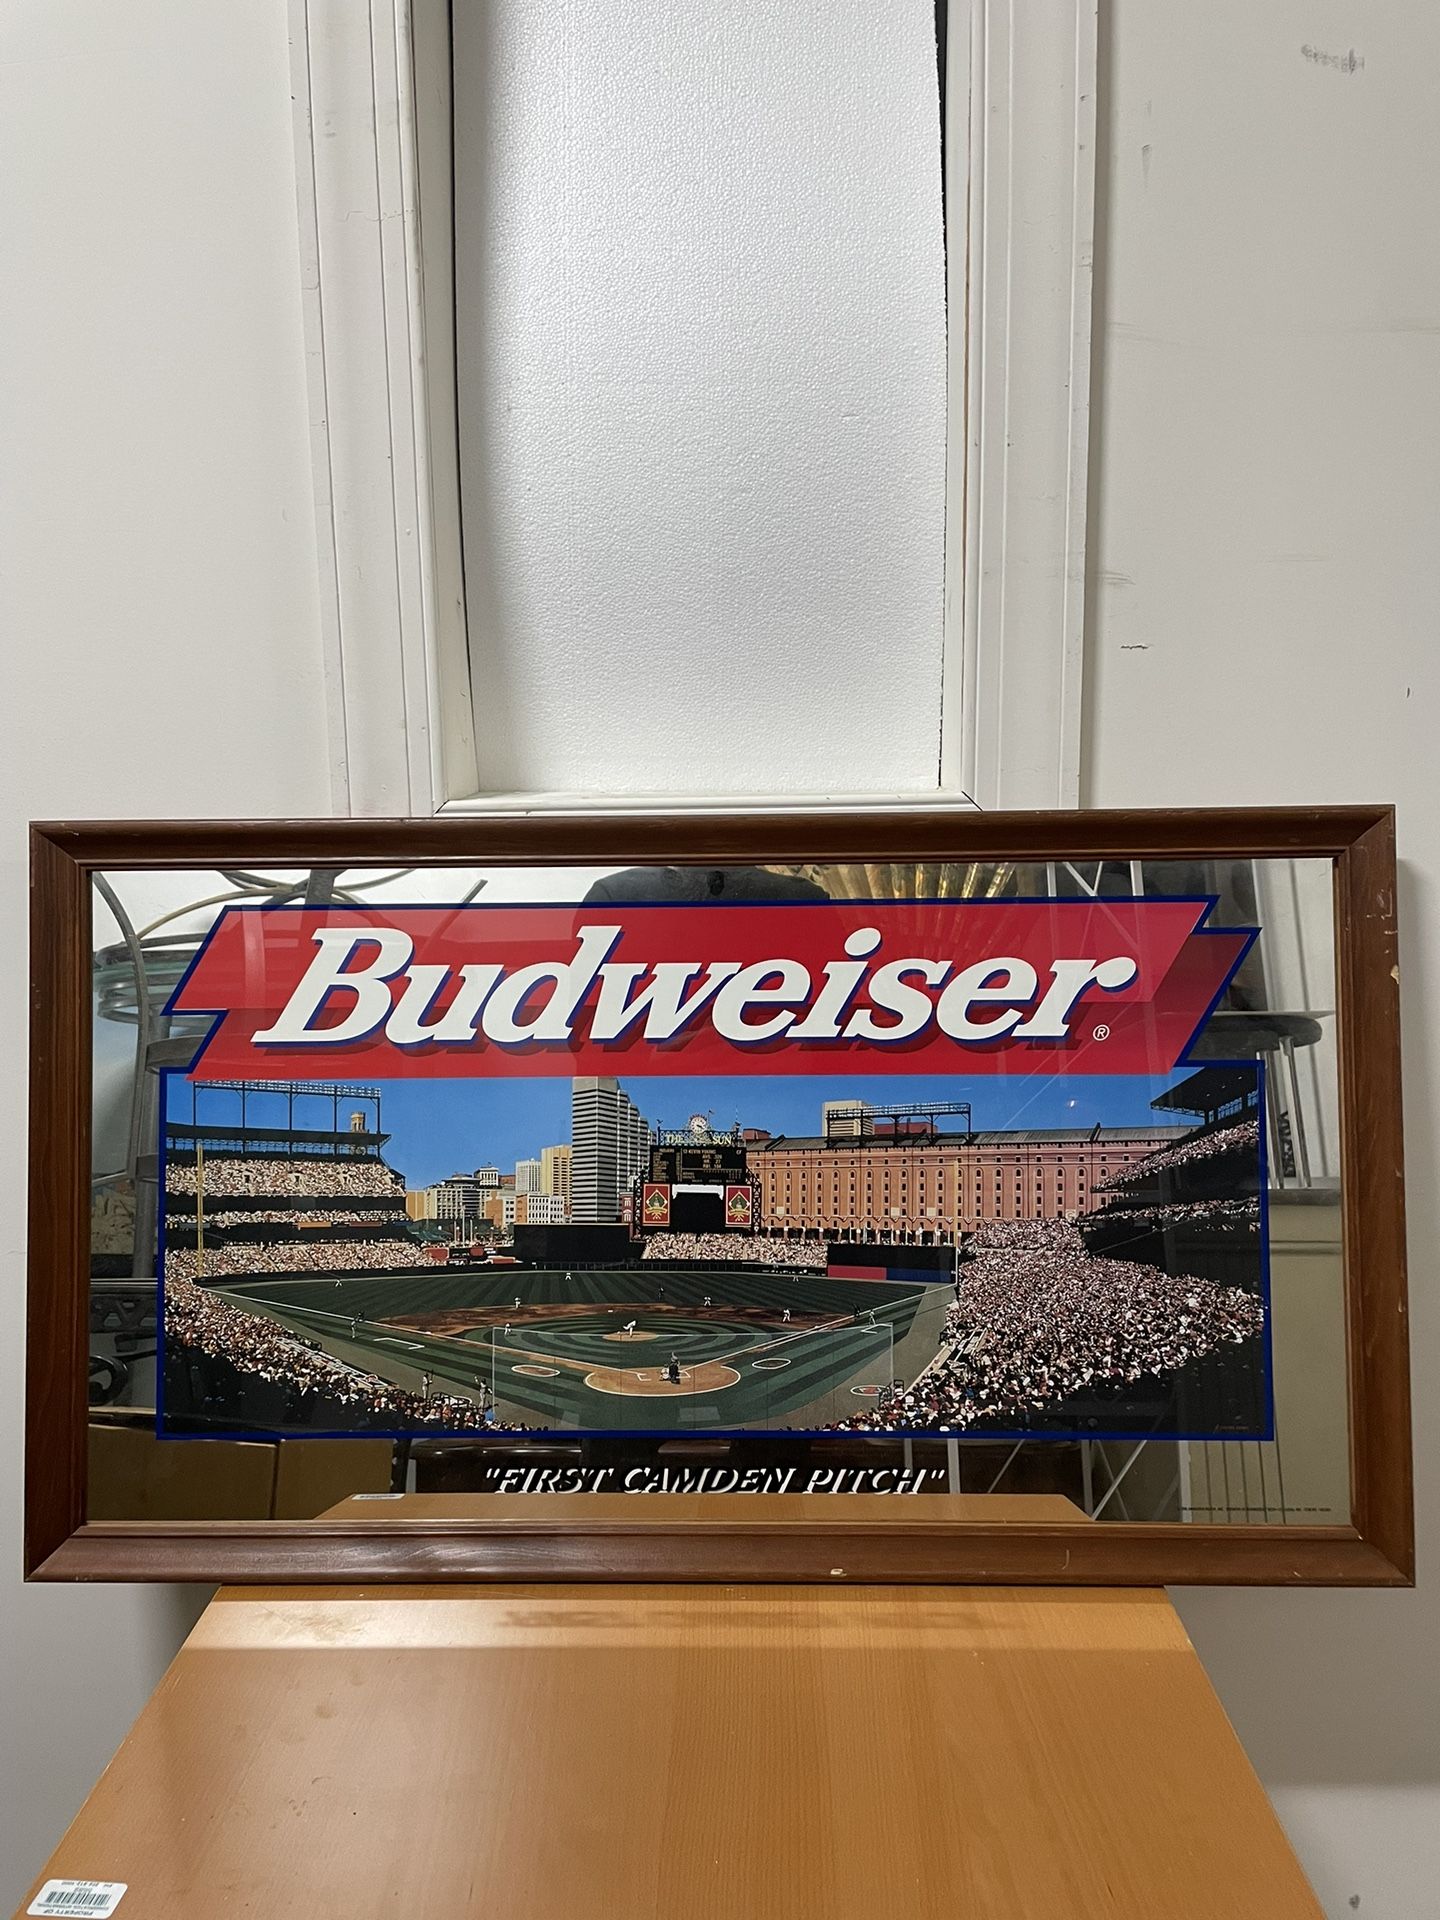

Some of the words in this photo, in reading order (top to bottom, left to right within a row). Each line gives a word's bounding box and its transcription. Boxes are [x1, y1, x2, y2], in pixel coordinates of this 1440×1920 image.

[251, 925, 1137, 1045] Budweiser
[712, 1133, 732, 1145] SUN
[484, 1466, 615, 1495] "FIRST
[623, 1466, 797, 1495] CAMDEN
[802, 1466, 947, 1495] PITCH"
[54, 1909, 95, 1917] PROPERTY
